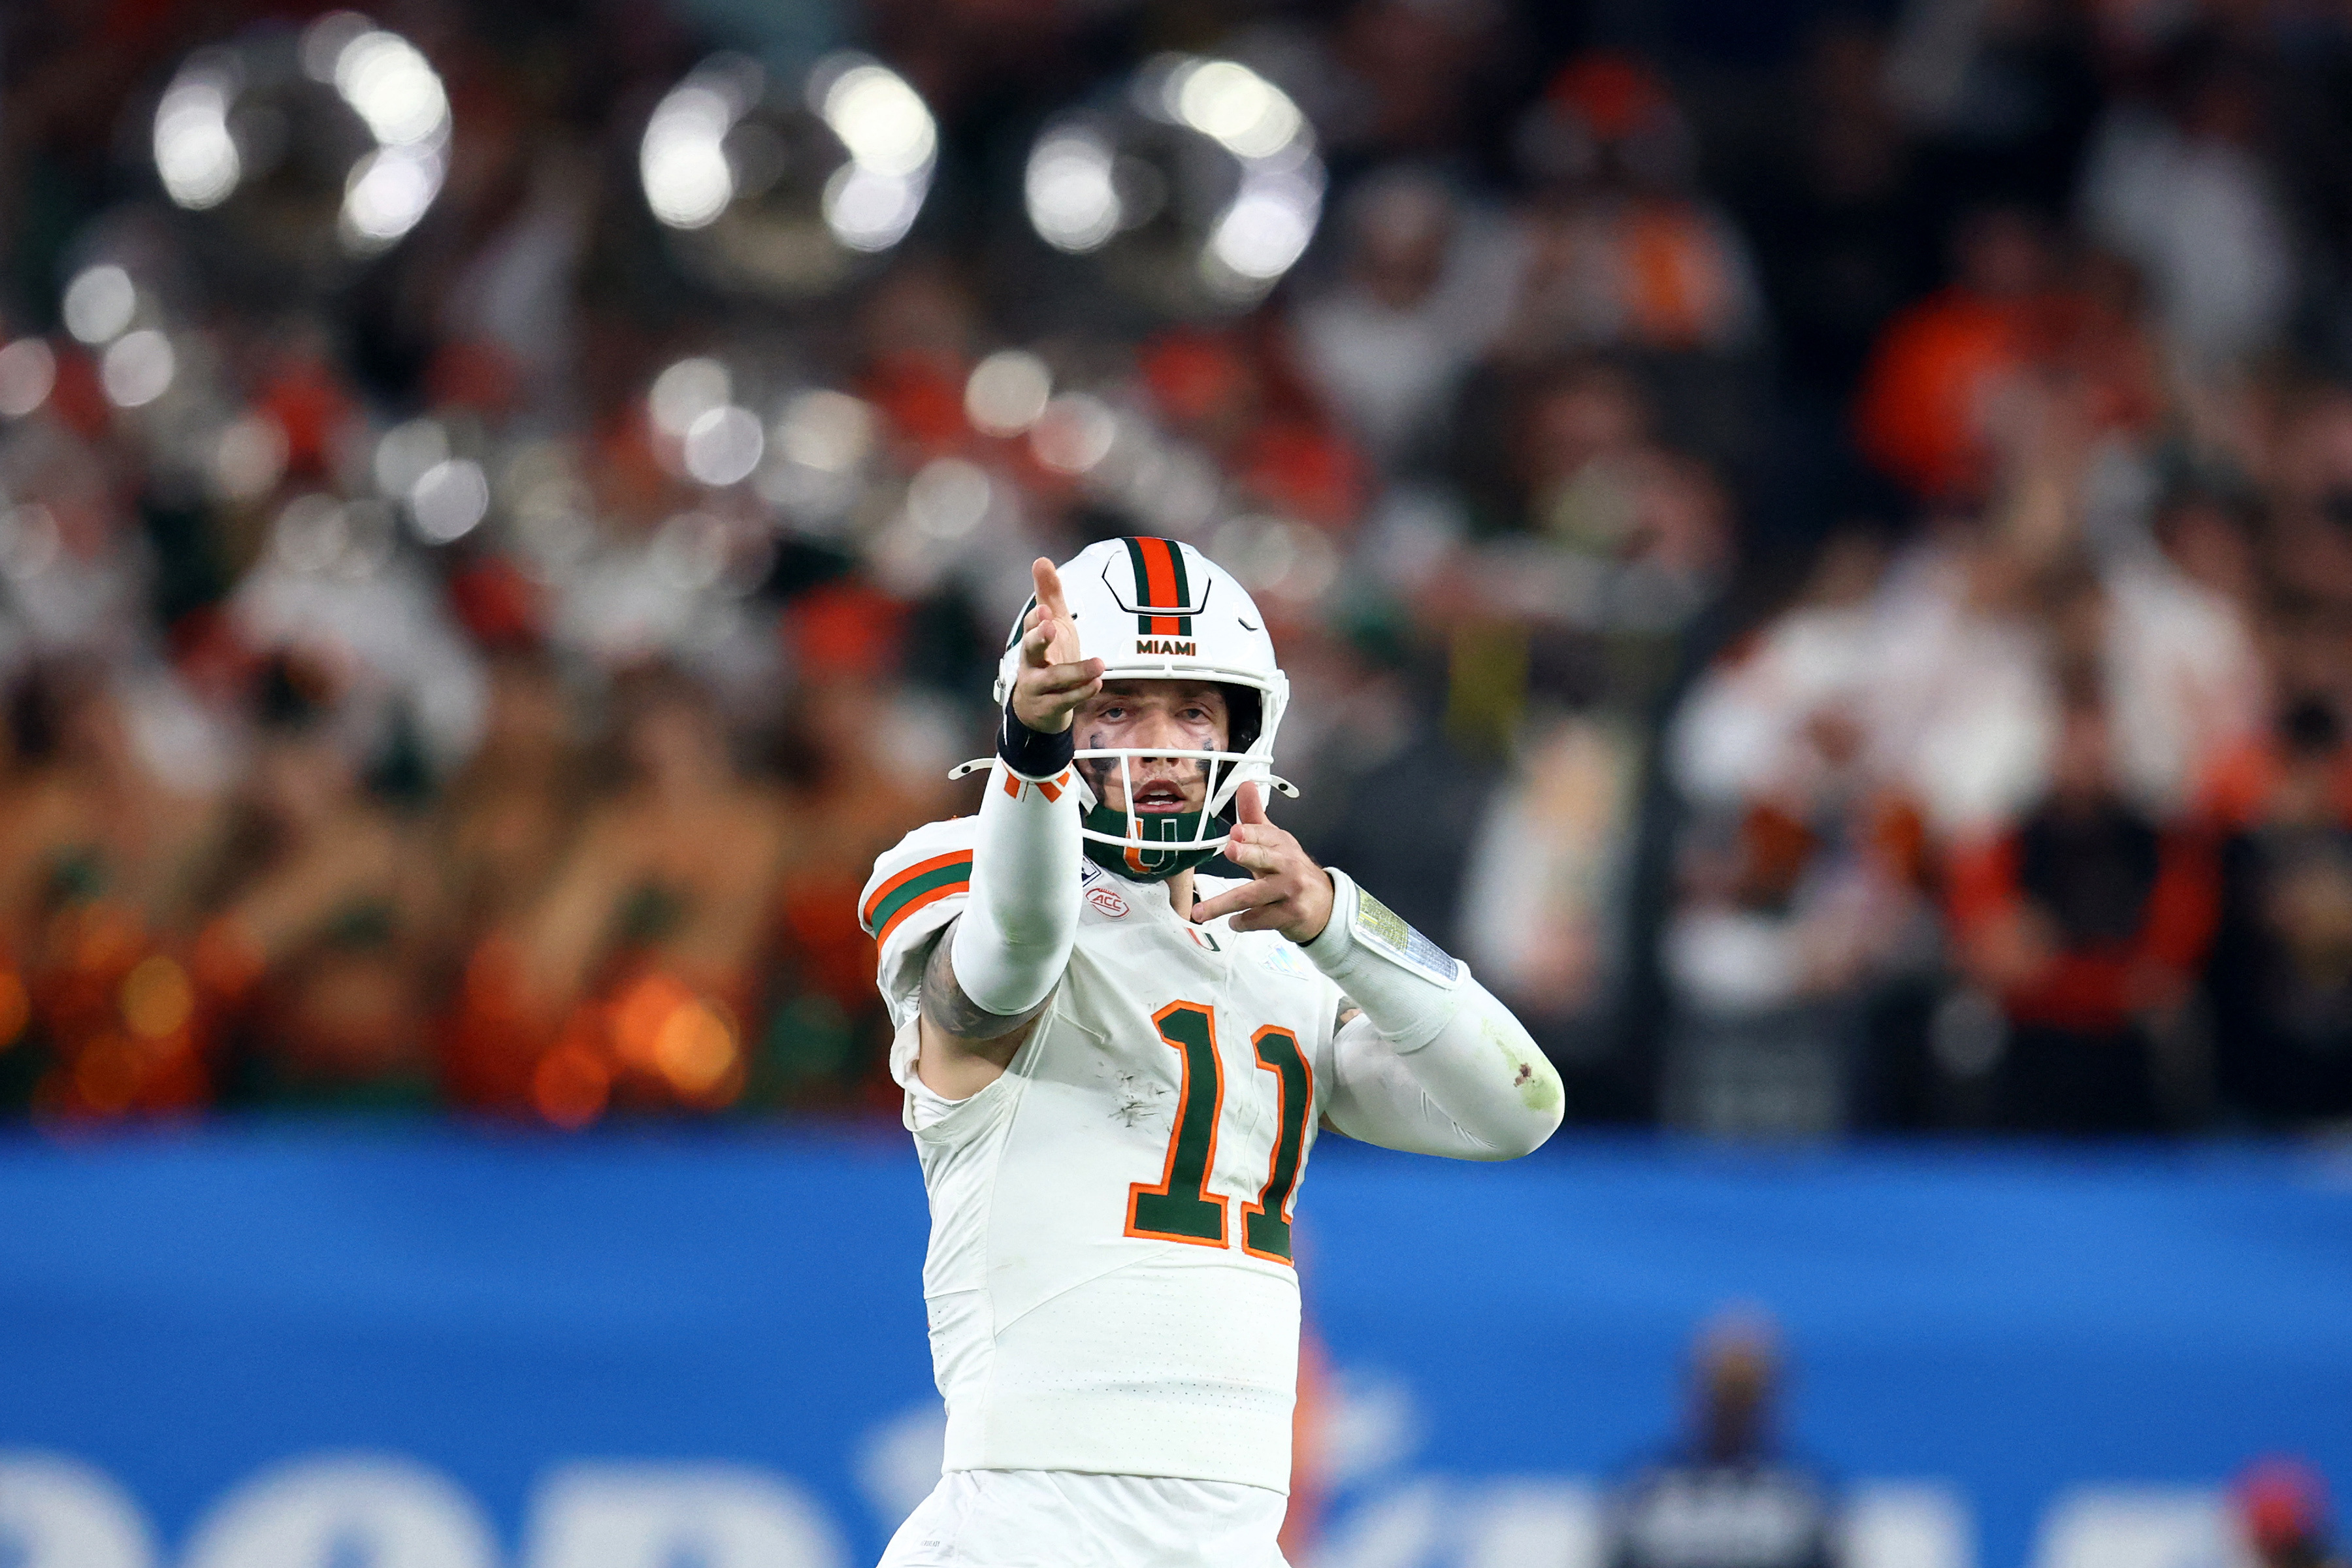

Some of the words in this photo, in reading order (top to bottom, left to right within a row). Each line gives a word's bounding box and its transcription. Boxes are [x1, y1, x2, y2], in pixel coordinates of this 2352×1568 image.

[1136, 640, 1196, 656] MIAMI
[1124, 817, 1178, 874] U
[1092, 894, 1122, 909] ACC
[1123, 999, 1313, 1267] 11
